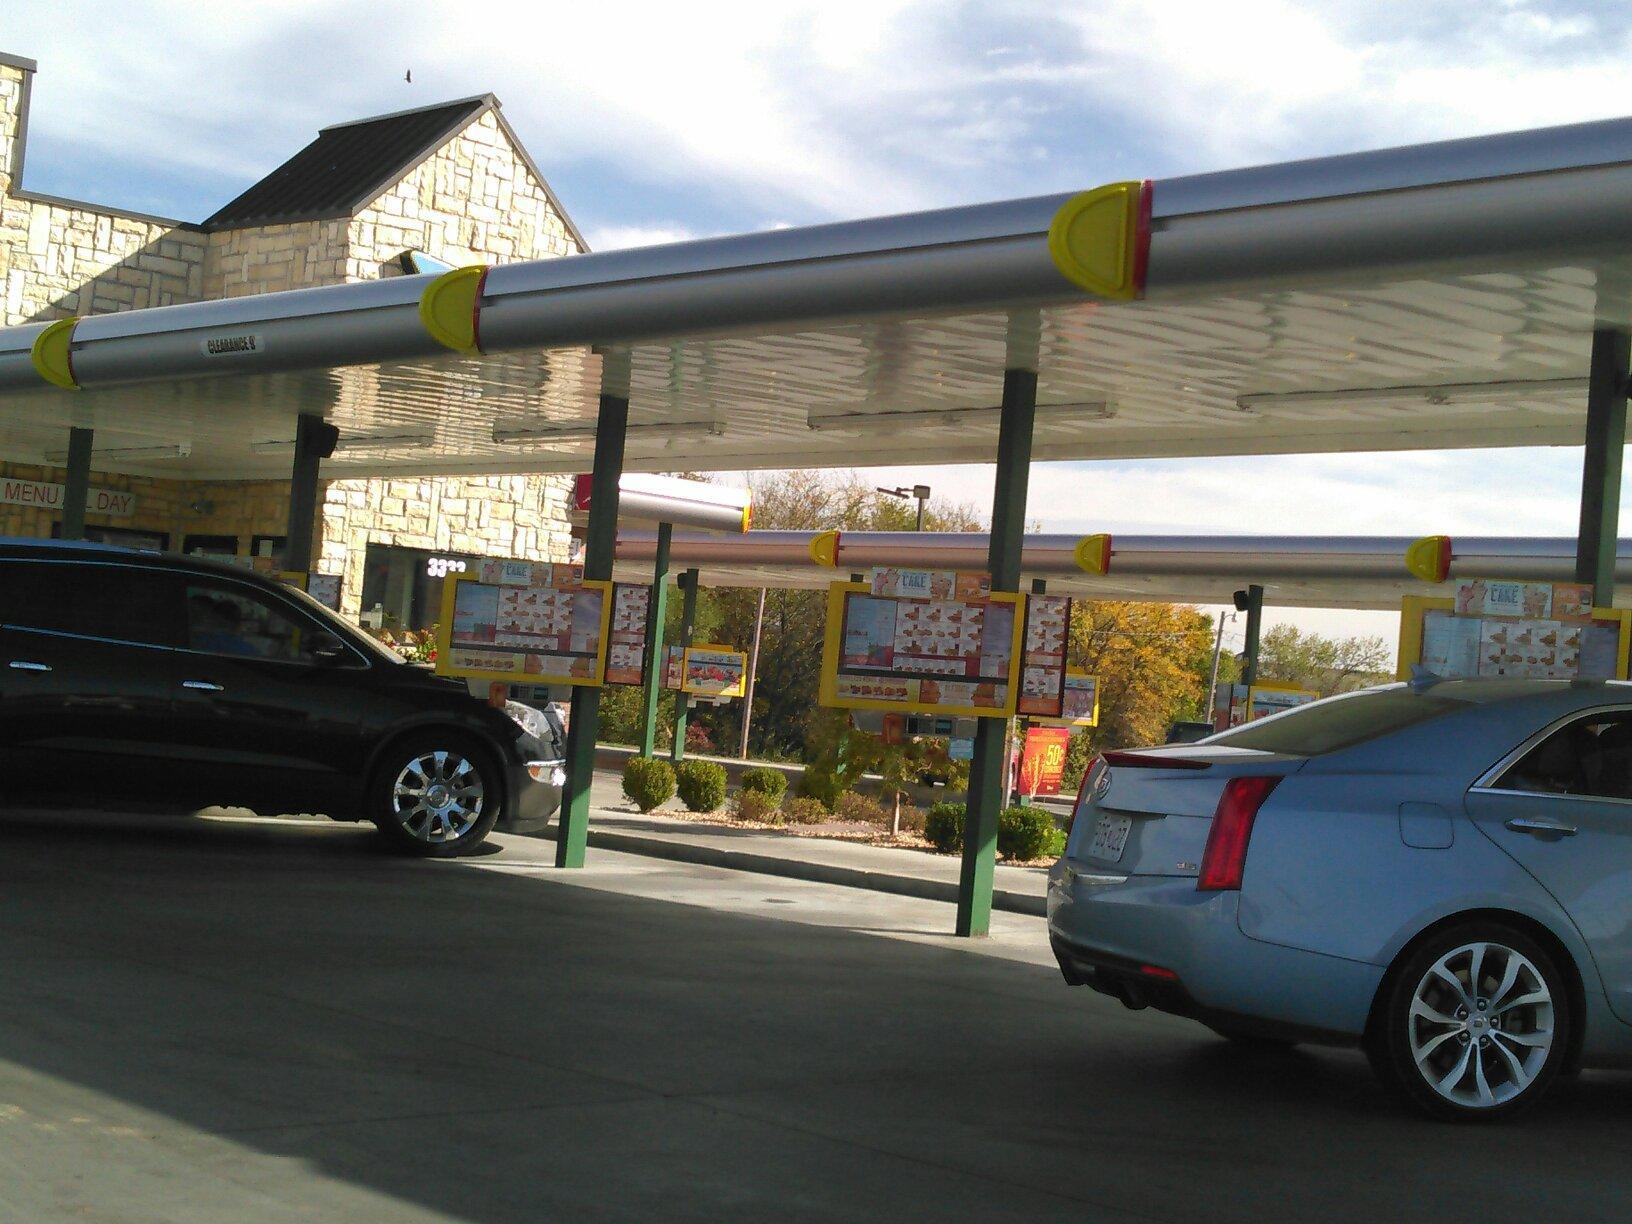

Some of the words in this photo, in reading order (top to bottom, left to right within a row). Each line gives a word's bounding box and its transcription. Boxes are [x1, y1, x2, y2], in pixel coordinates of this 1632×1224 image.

[208, 338, 248, 354] CLEARANCE
[5, 482, 59, 504] MENU
[98, 492, 131, 512] DAY
